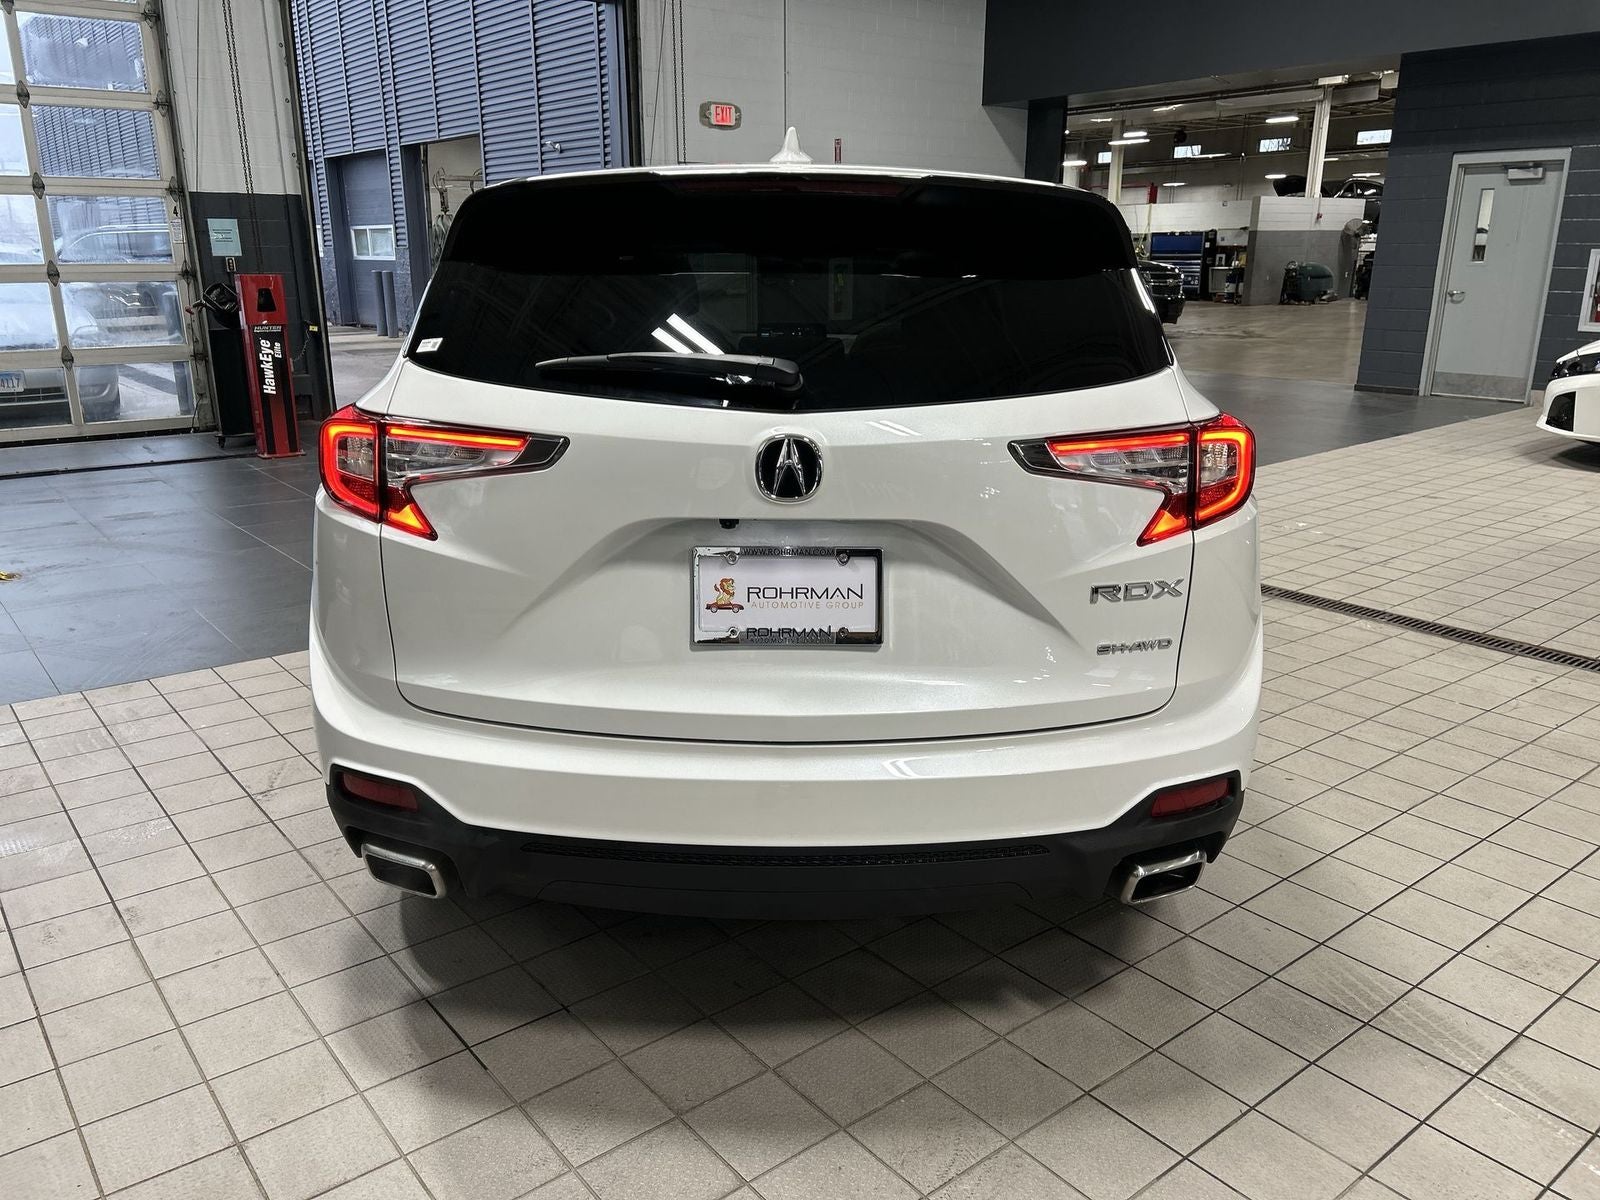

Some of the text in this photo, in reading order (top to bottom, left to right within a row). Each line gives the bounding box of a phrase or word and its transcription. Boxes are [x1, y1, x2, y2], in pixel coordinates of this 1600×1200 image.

[715, 105, 732, 123] EXIT
[274, 342, 282, 358] Elite
[259, 339, 277, 395] HawkEye
[741, 547, 835, 556] WWW.ROHRMAN.COM
[747, 583, 864, 602] ROHRMAN
[1090, 578, 1184, 604] RDX
[751, 601, 864, 609] AUTOMOTIVE GROUP
[746, 625, 832, 639] ROHRMAN
[1096, 638, 1173, 656] SH-AWD
